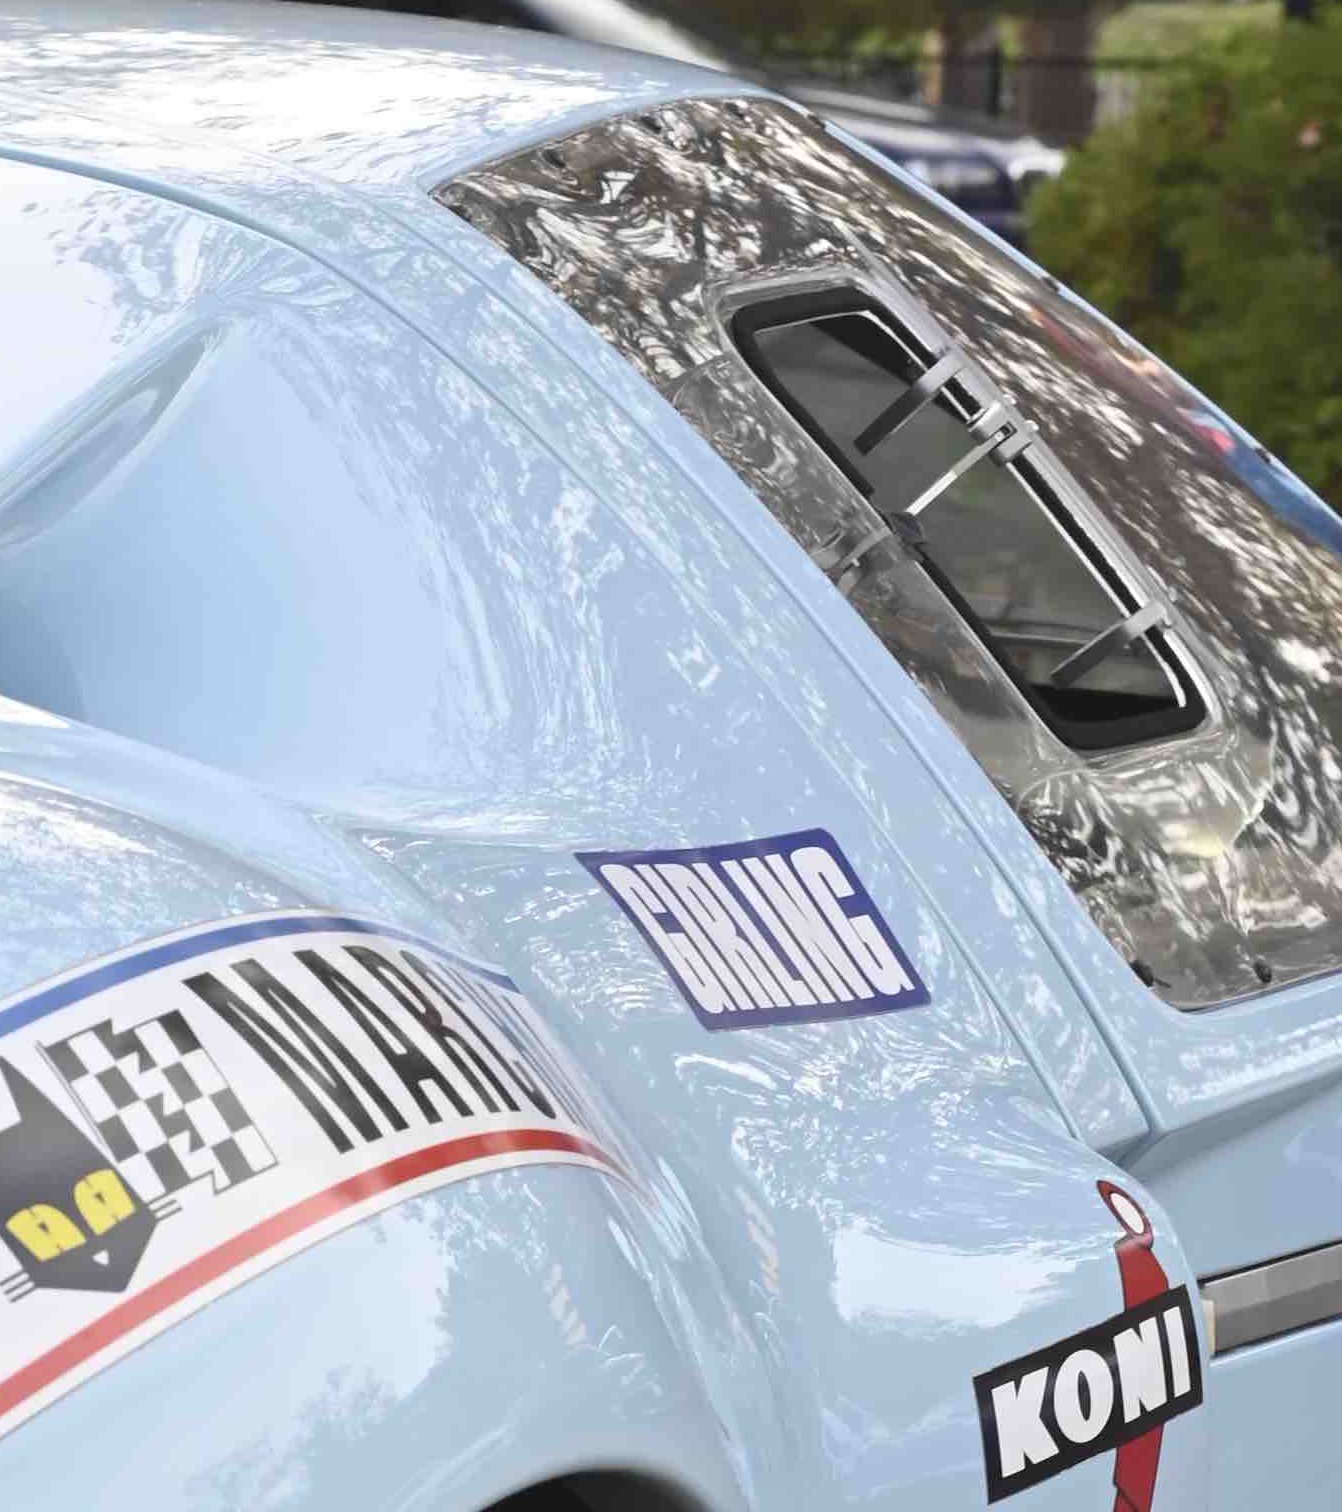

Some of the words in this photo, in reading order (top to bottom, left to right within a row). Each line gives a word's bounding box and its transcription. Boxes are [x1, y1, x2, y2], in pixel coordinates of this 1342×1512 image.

[600, 846, 915, 1014] GIRLING
[182, 944, 609, 1155] MARC
[990, 1305, 1191, 1479] KONI
